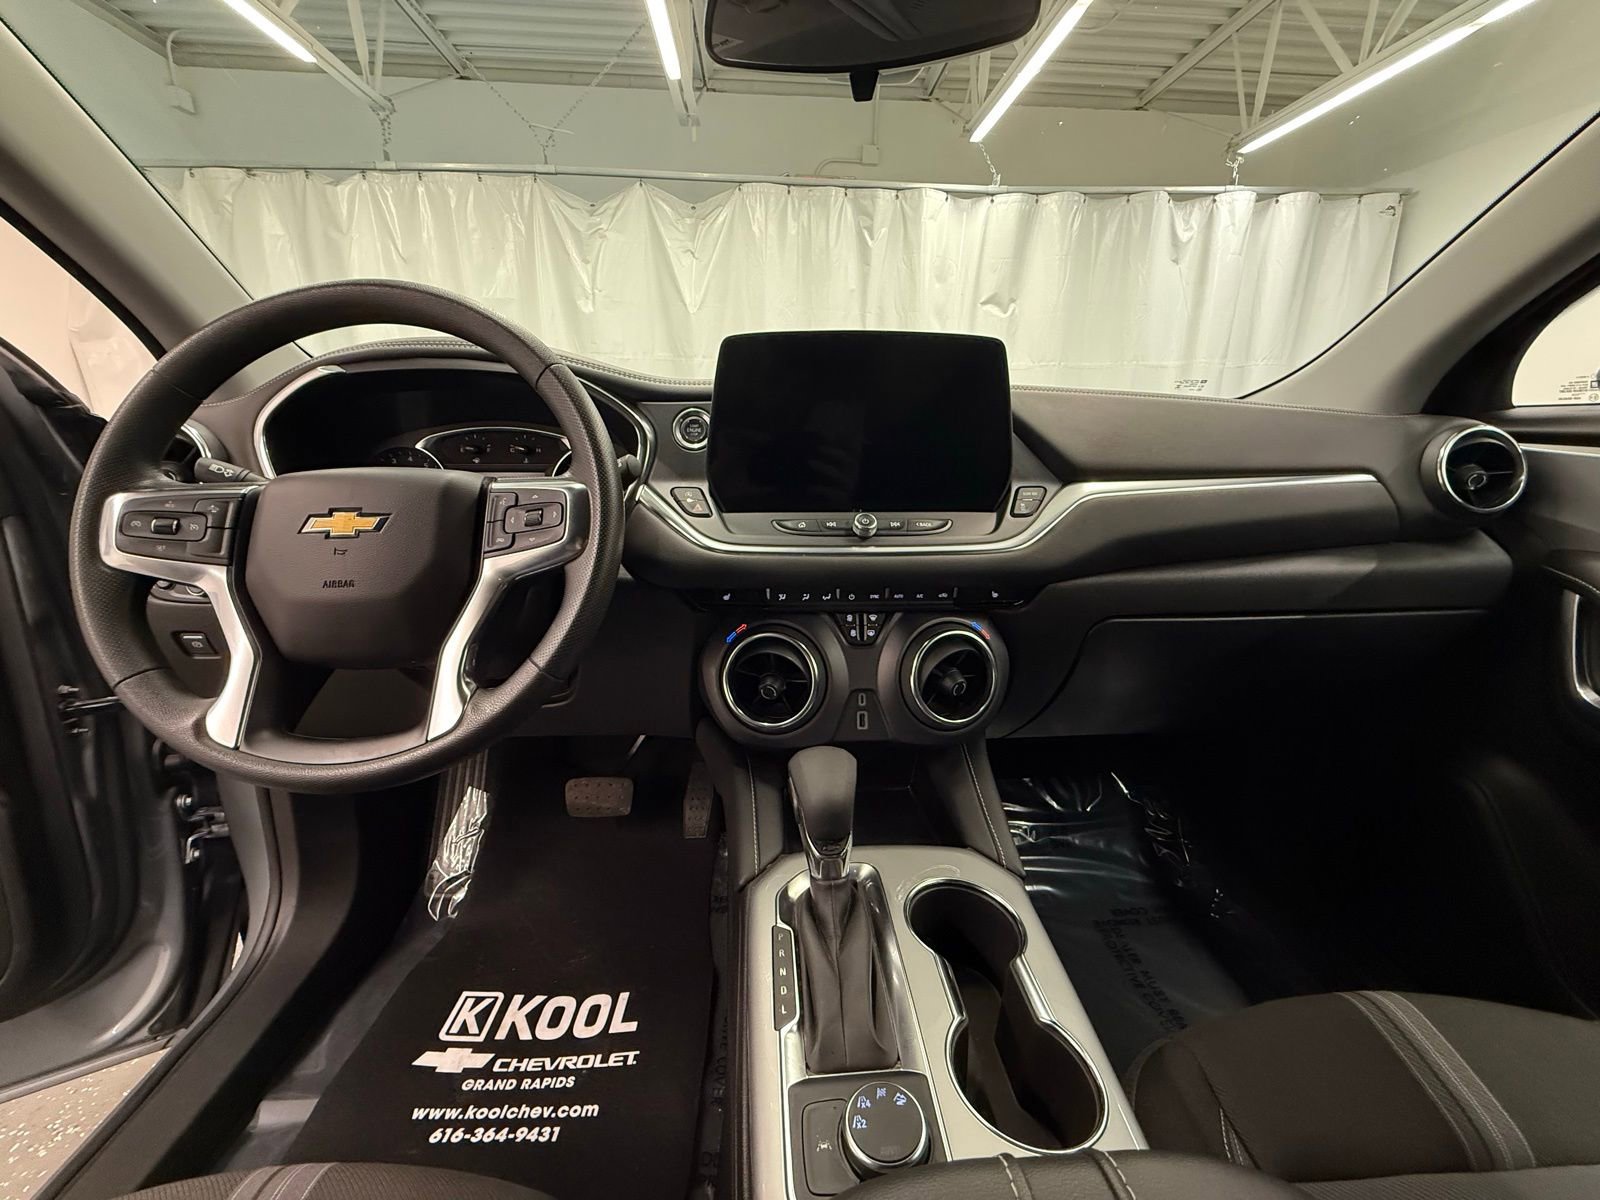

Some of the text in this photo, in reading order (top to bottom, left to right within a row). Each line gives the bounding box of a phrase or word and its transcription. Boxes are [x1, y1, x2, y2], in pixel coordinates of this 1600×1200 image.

[778, 932, 784, 942] P
[779, 949, 785, 957] R
[780, 967, 787, 977] N
[781, 985, 787, 995] D
[781, 1004, 787, 1014] L
[494, 991, 639, 1040] KOOL
[461, 1076, 576, 1091] GRAND RAPIDS
[411, 1103, 600, 1120] www.koolchev.com
[428, 1126, 561, 1144] 616-364-9431
